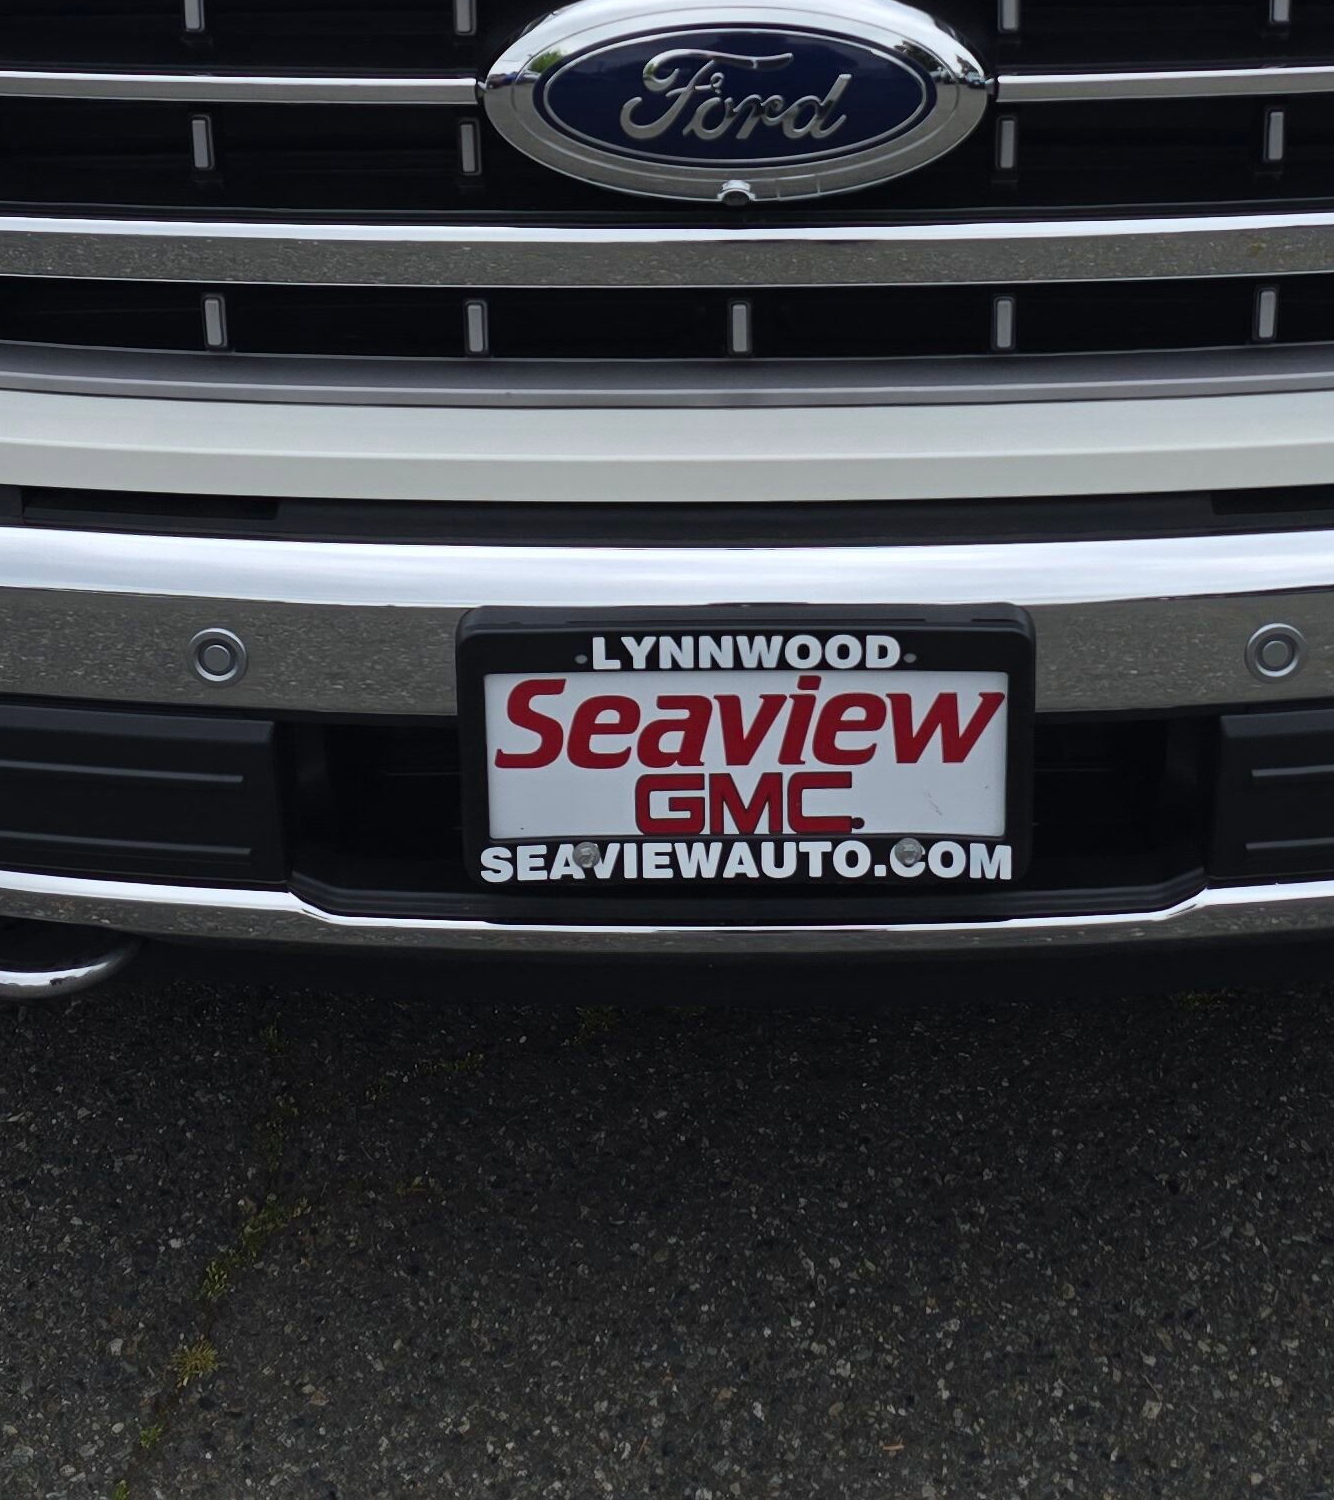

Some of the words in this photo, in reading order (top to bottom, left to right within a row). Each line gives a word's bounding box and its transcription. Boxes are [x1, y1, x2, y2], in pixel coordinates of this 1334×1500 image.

[620, 49, 852, 140] Ford
[591, 635, 901, 670] LYNNWOOD
[494, 675, 1006, 769] Seaview
[480, 841, 1012, 883] SEAVIEWAUTO.COM
